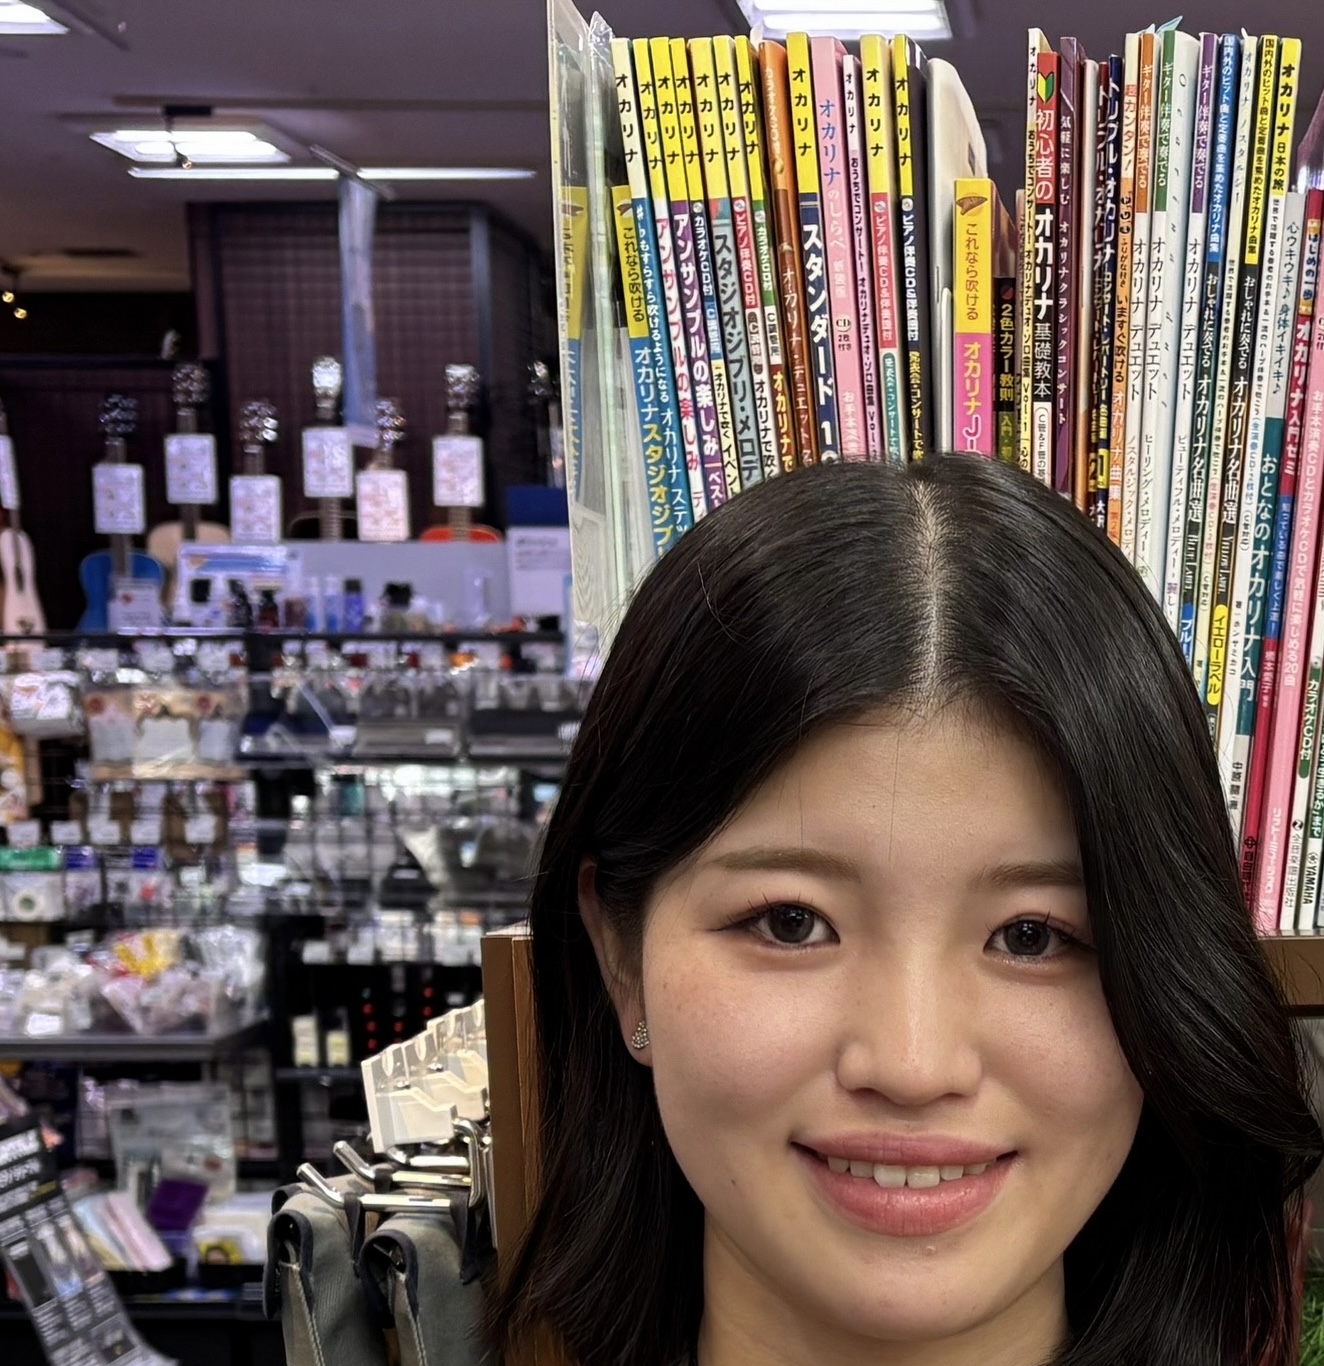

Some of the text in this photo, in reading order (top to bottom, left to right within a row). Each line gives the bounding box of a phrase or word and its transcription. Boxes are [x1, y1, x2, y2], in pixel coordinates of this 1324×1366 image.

[616, 73, 638, 163] オカリナ
[641, 81, 663, 169] オカリナ
[676, 75, 699, 164] オカリナ
[696, 74, 719, 162] オカリナ
[718, 72, 740, 161] オカリナ
[846, 73, 857, 135] オカリナ
[866, 68, 884, 157] オカリナ
[896, 78, 912, 167] オカリナ
[1272, 63, 1296, 191] オカリナ 日本の旅
[819, 100, 847, 248] オカリナのしらべ
[1035, 109, 1055, 200] 初心者の
[1102, 78, 1120, 264] トリプル・オカリナ
[658, 76, 680, 164] オカリナ
[673, 213, 719, 455] アンサンブルの楽しみ
[740, 80, 759, 155] オカリナ
[773, 371, 794, 473] オカリナで
[792, 68, 834, 406] オカリナ スタンダード
[1057, 116, 1071, 424] 気軽に楽しむ オカリナクラシックコンサート
[1132, 238, 1147, 312] オカリナ
[1150, 238, 1166, 312] オカリナ
[1187, 238, 1201, 312] オカリナ
[963, 223, 982, 415] これなら吹ける オカリナ
[1033, 208, 1054, 398] オカリナ基礎教本
[1114, 295, 1128, 383] いますぐ吹ける
[1237, 275, 1256, 369] おしゃれに奏でる
[1000, 303, 1016, 402] 2色カラー教則
[1130, 324, 1144, 401] デュエット
[1146, 323, 1163, 401] デュエット
[1180, 324, 1197, 401] デュエット
[1282, 234, 1318, 475] はじめの一歩 オカリナ入門ゼミ
[661, 409, 682, 483] オカリナ
[1186, 375, 1212, 524] オカリナ名曲選
[1223, 376, 1247, 524] オカリナ名曲選
[1238, 453, 1278, 701] おとなのオカリナ入門
[1208, 615, 1227, 695] イエローラベル
[1302, 866, 1318, 905] YAMAHA
